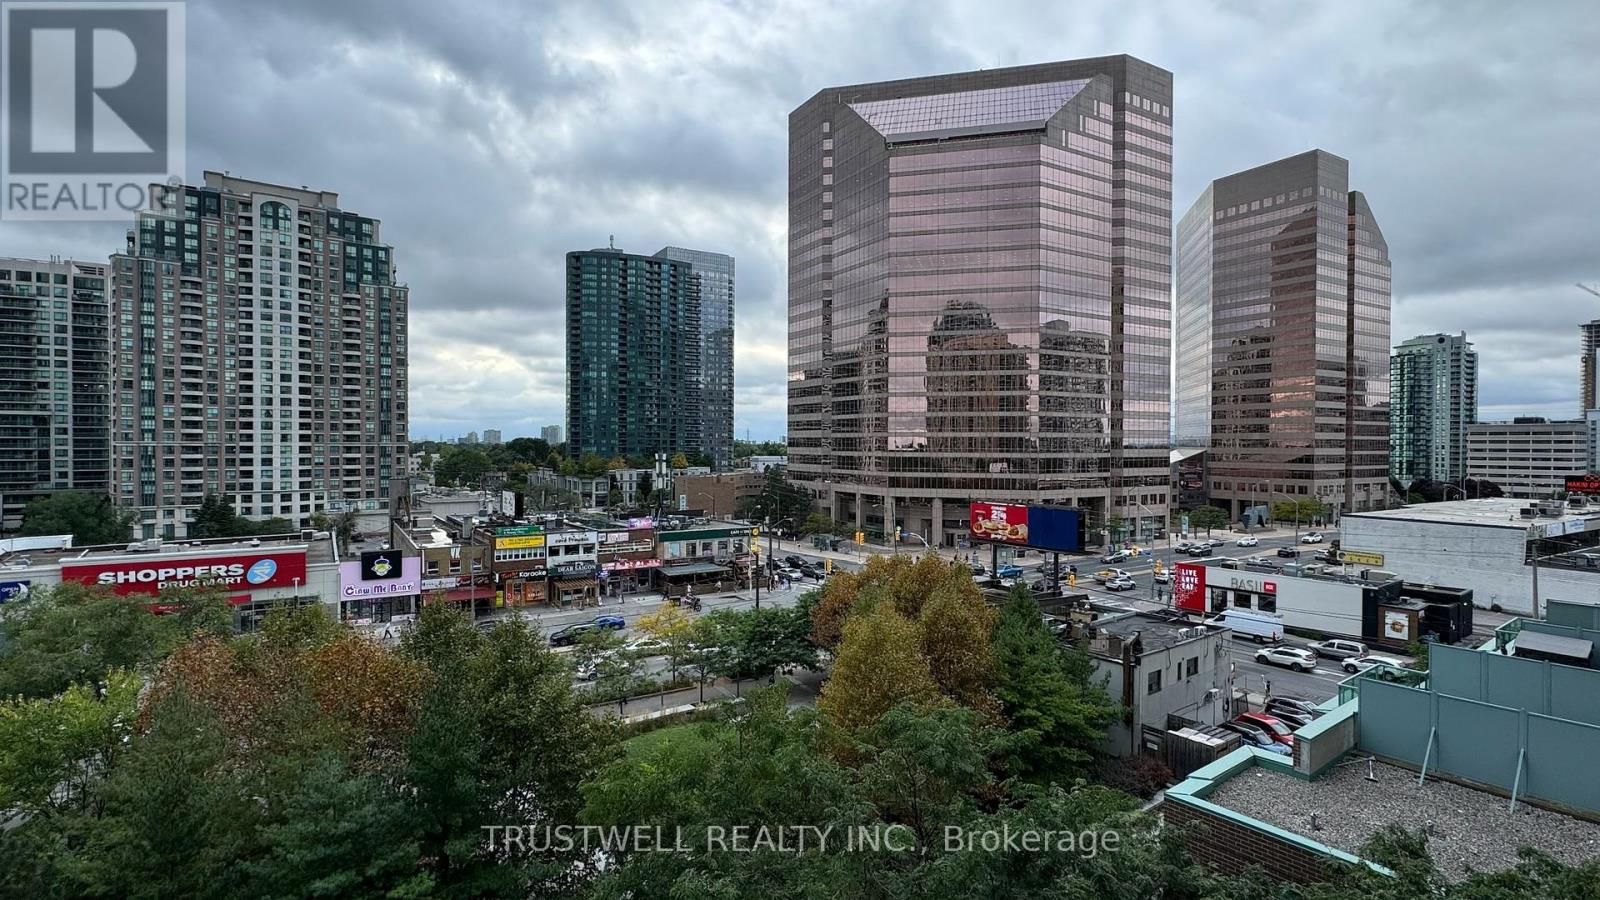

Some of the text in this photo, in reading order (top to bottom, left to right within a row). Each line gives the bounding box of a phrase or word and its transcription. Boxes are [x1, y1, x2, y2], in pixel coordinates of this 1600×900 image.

[97, 564, 244, 585] SHOPPERS
[1181, 569, 1197, 577] LIVE
[157, 580, 199, 590] DRUG
